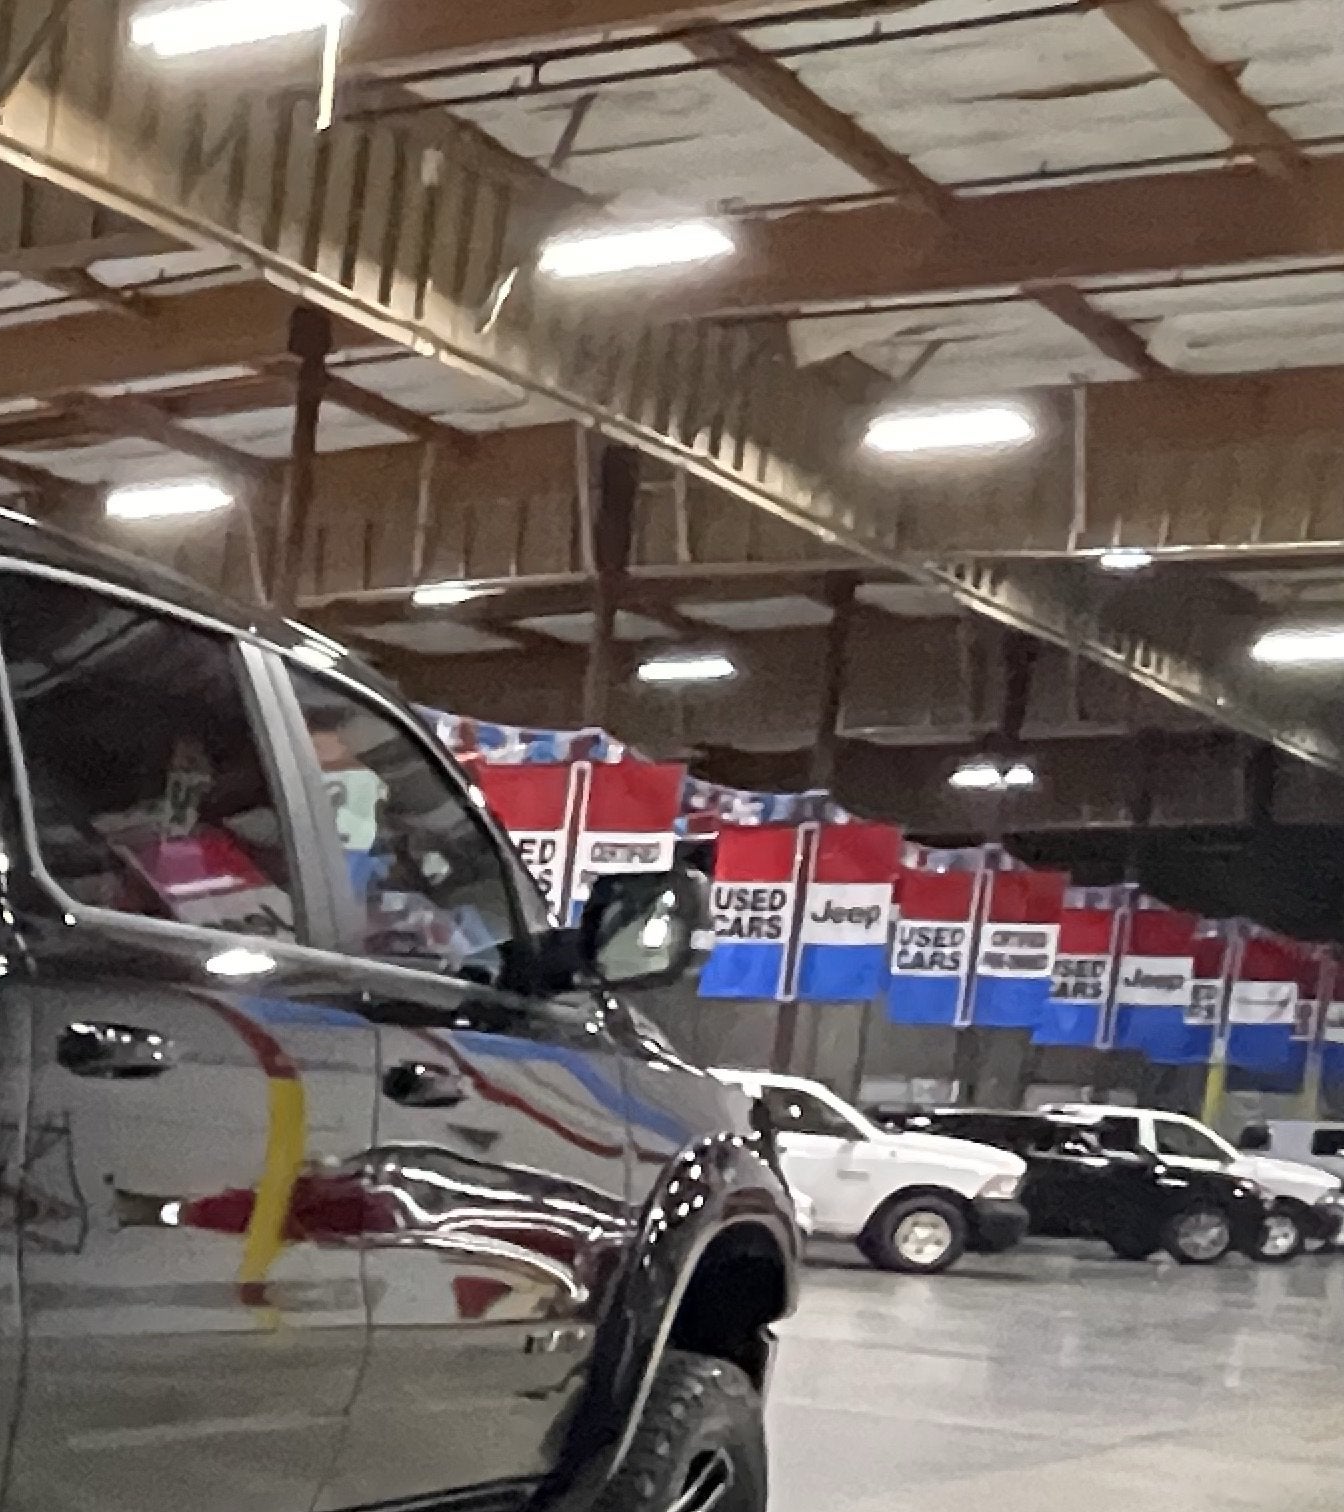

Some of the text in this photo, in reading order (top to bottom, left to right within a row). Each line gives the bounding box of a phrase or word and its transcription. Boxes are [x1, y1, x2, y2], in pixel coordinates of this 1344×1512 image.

[518, 838, 556, 864] ED
[715, 886, 788, 912] USED
[713, 914, 782, 939] CARS
[811, 899, 881, 930] Jeep
[898, 926, 965, 948] USED
[896, 950, 960, 970] CARS
